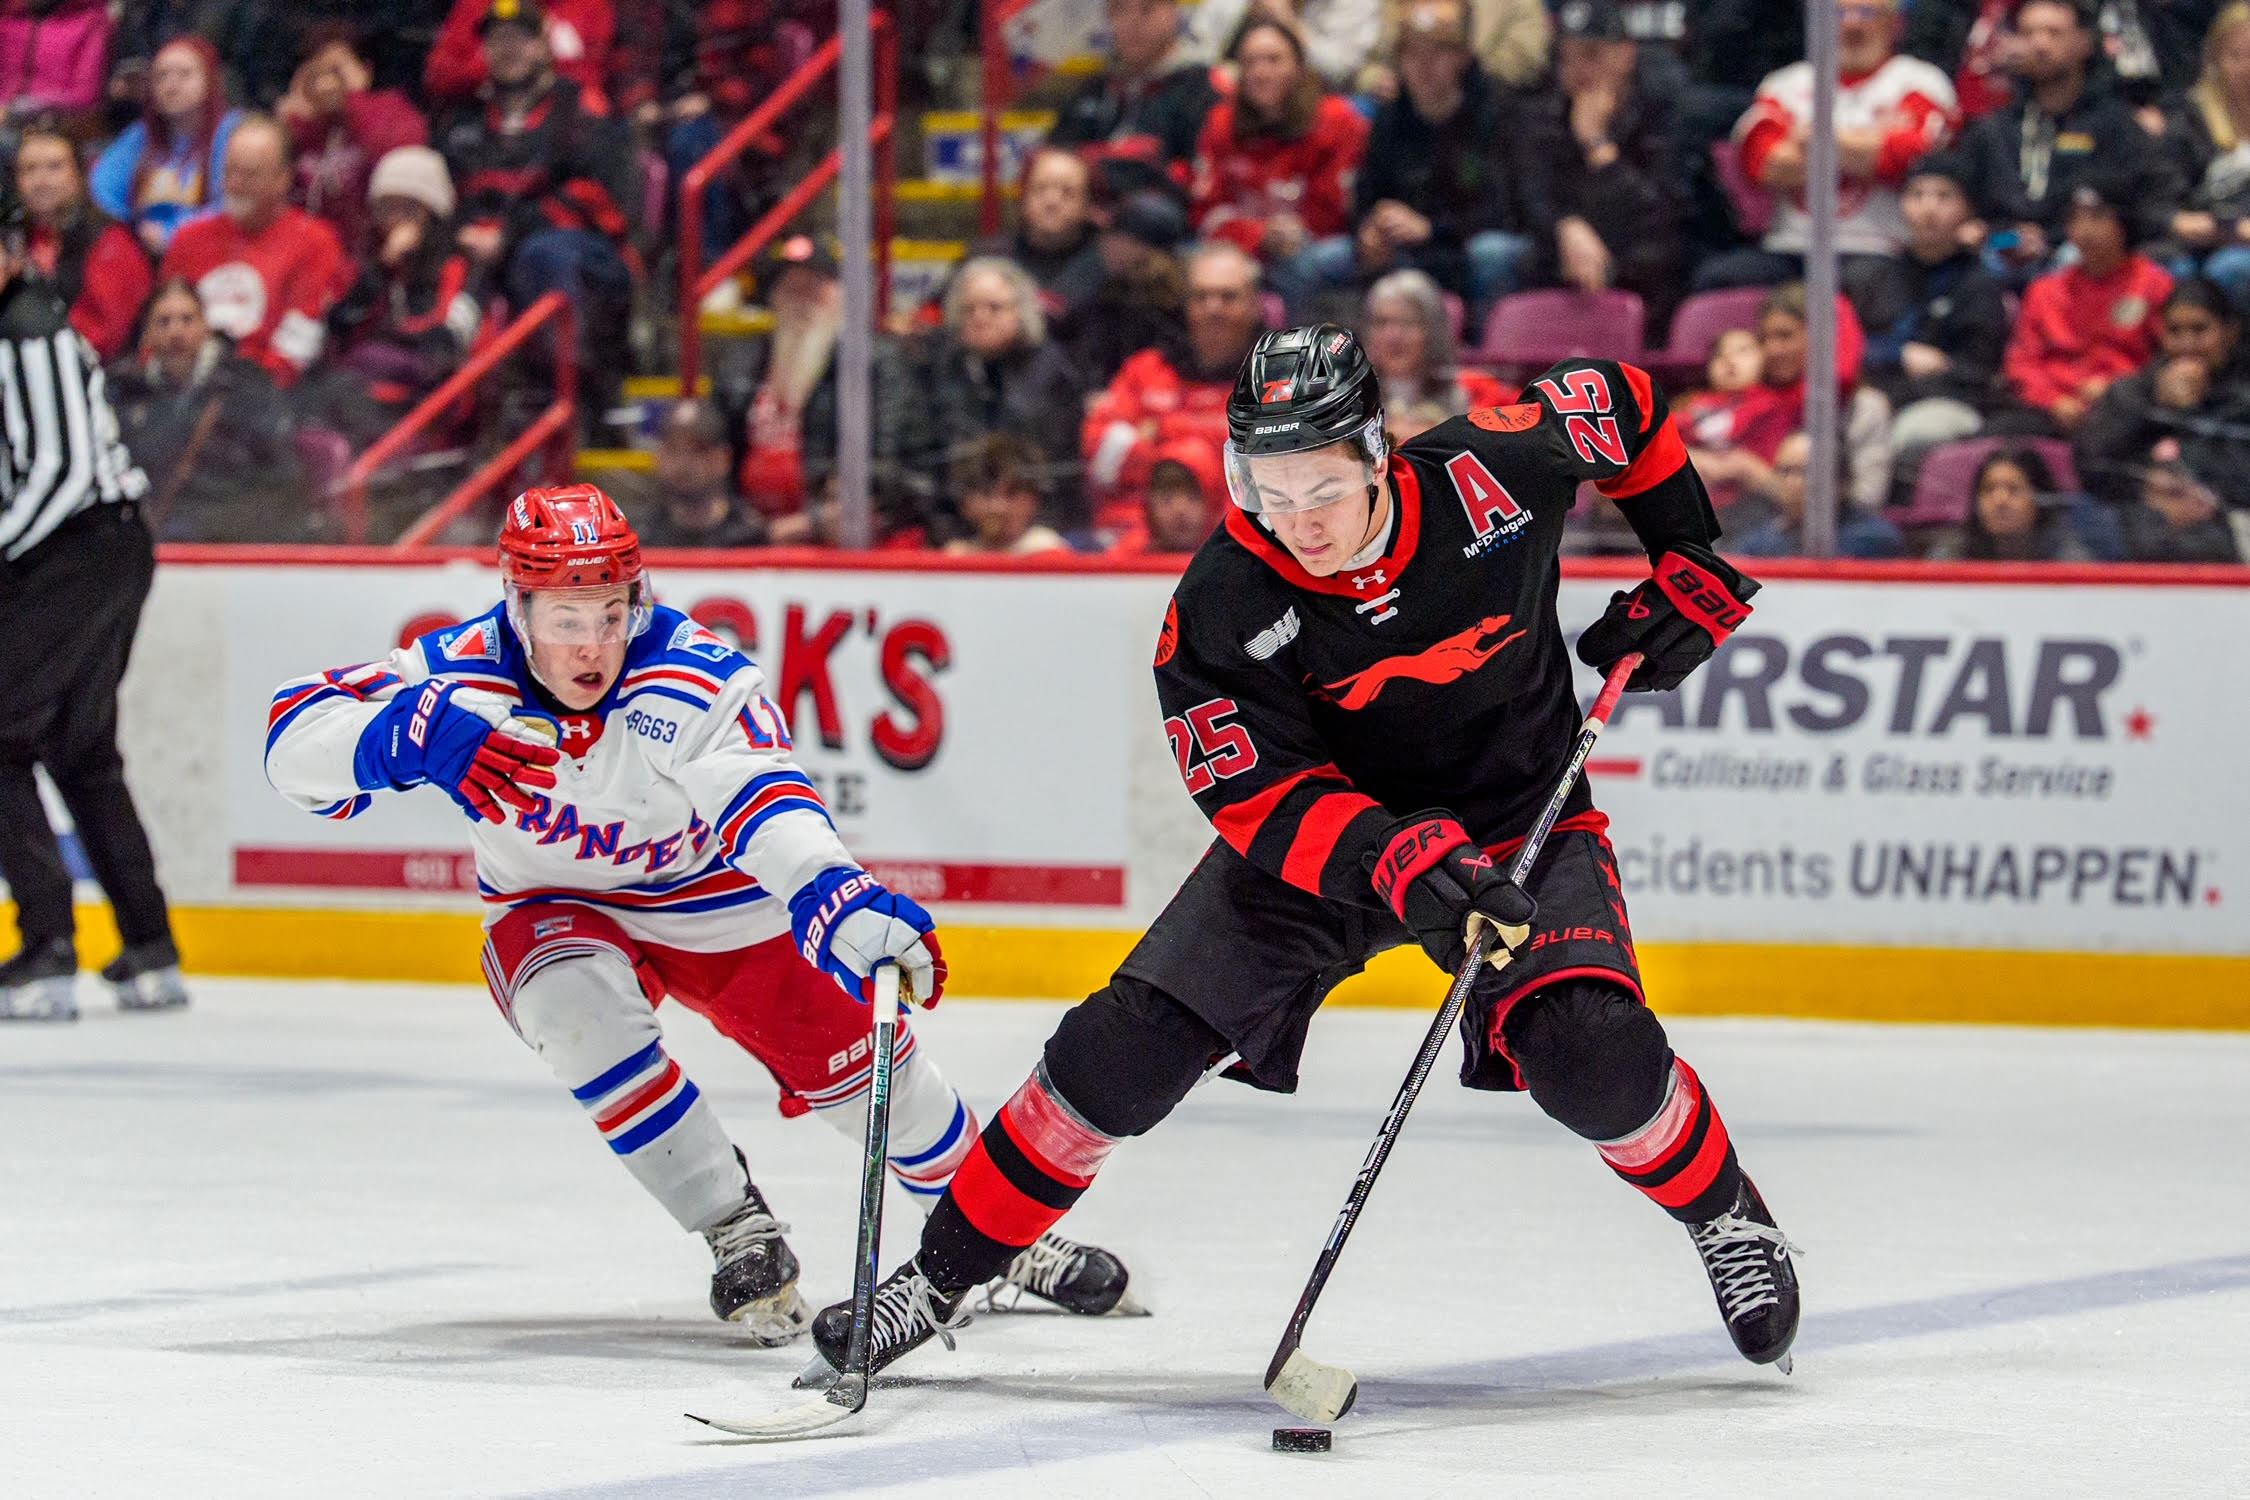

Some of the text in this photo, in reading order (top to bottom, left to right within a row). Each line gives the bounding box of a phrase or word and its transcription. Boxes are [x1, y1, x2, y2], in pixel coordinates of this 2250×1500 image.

[1261, 379, 1292, 405] 25
[1532, 368, 1629, 465] 25
[1254, 422, 1300, 435] BAUER
[1444, 450, 1522, 539] A
[567, 556, 611, 567] BAUER
[572, 522, 598, 545] 11
[1463, 509, 1534, 559] McDougall
[1667, 569, 1747, 630] BAU
[408, 680, 458, 749] BAU
[736, 695, 793, 752] 11
[1164, 697, 1259, 796] 25
[1652, 749, 2115, 799] Collision & Glass Service
[1619, 834, 1836, 900] cidents
[803, 870, 881, 968] BAUER
